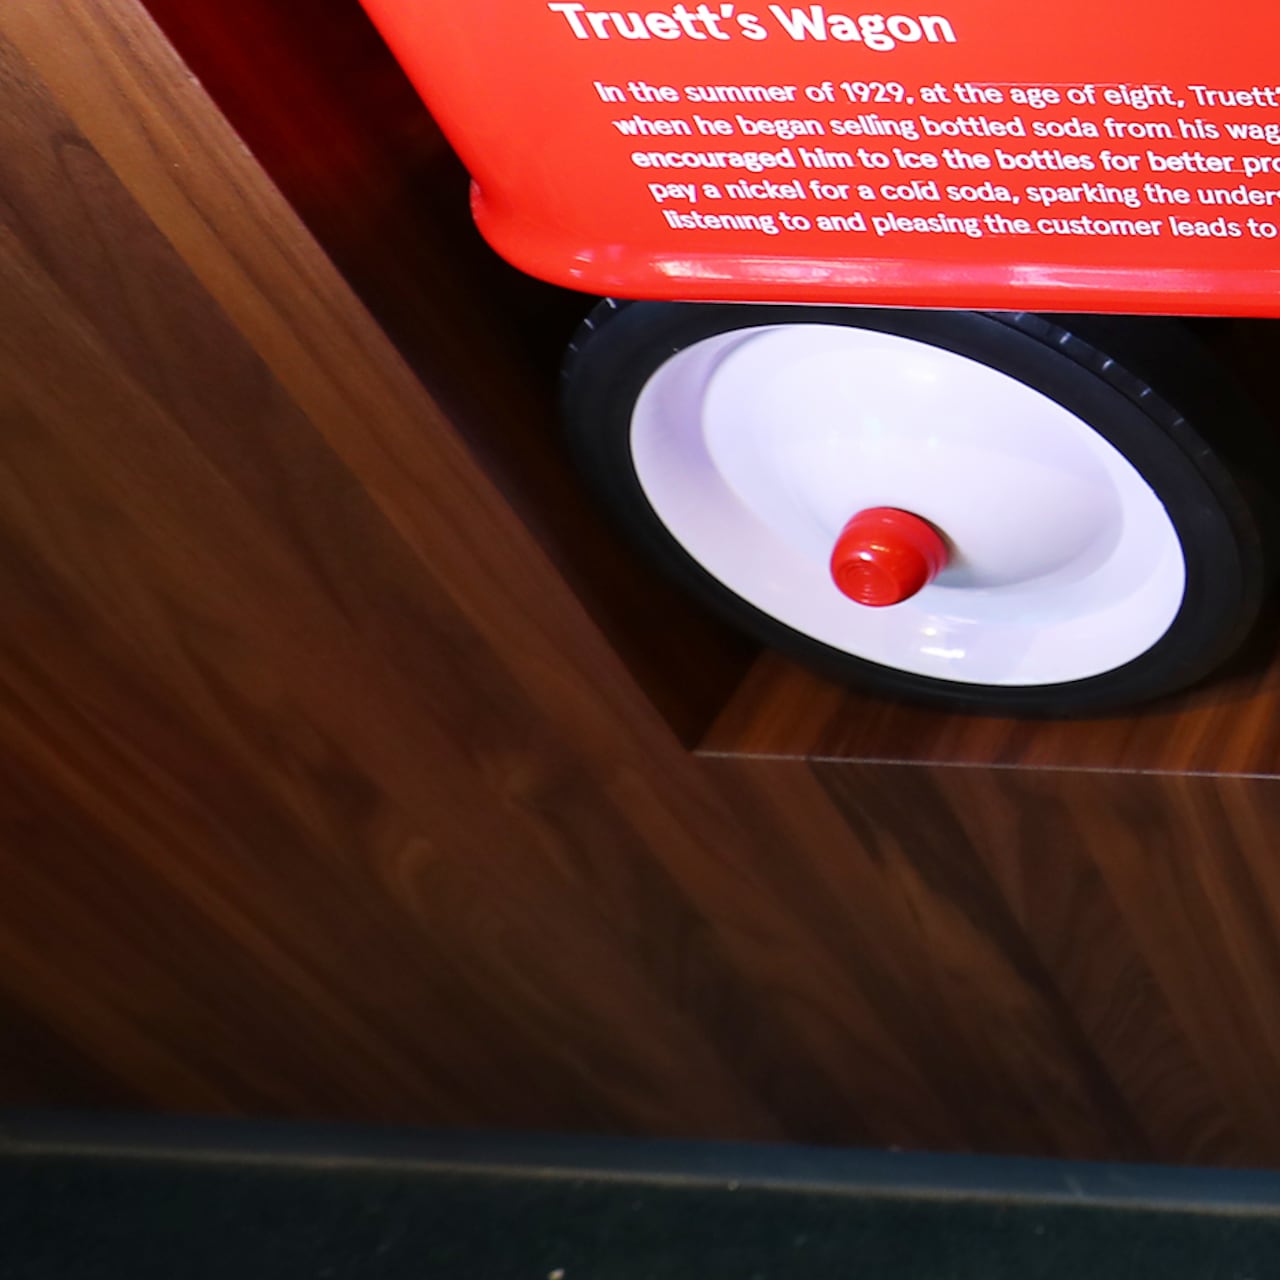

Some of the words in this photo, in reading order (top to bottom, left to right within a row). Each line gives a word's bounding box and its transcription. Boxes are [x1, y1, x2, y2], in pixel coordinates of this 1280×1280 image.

[768, 5, 957, 51] Wagon
[594, 82, 624, 102] In
[628, 82, 679, 102] the
[684, 86, 797, 103] summer
[805, 82, 836, 103] of
[840, 82, 914, 105] 1929,
[920, 84, 951, 104] at
[954, 84, 1003, 104] the
[1010, 89, 1060, 109] age
[1067, 84, 1097, 104] of
[1103, 86, 1184, 109] eight,
[612, 116, 690, 135] when
[694, 116, 733, 135] he
[736, 115, 824, 139] began
[830, 115, 919, 140] selling
[923, 117, 1027, 137] bottled
[1032, 118, 1099, 138] soda
[1104, 118, 1172, 138] from
[1178, 119, 1219, 139] his
[632, 148, 796, 172] encouraged
[798, 148, 854, 168] him
[857, 149, 889, 169] to
[893, 148, 938, 169] ice
[942, 149, 990, 169] the
[995, 149, 1095, 170] bottles
[1099, 151, 1141, 171] for
[1147, 151, 1233, 173] better
[648, 184, 696, 203] pay
[702, 184, 721, 198] a
[725, 180, 806, 199] nickel
[809, 180, 849, 199] for
[857, 185, 875, 199] a
[880, 181, 940, 200] cold
[946, 182, 1019, 204] soda,
[1026, 183, 1141, 208] sparking
[1144, 184, 1190, 203] the
[663, 210, 775, 234] listening
[779, 213, 811, 231] to
[816, 212, 866, 232] and
[872, 212, 981, 236] pleasing
[985, 214, 1033, 234] the
[1037, 217, 1163, 236] customer
[1169, 216, 1242, 237] leads
[1247, 219, 1278, 238] to
